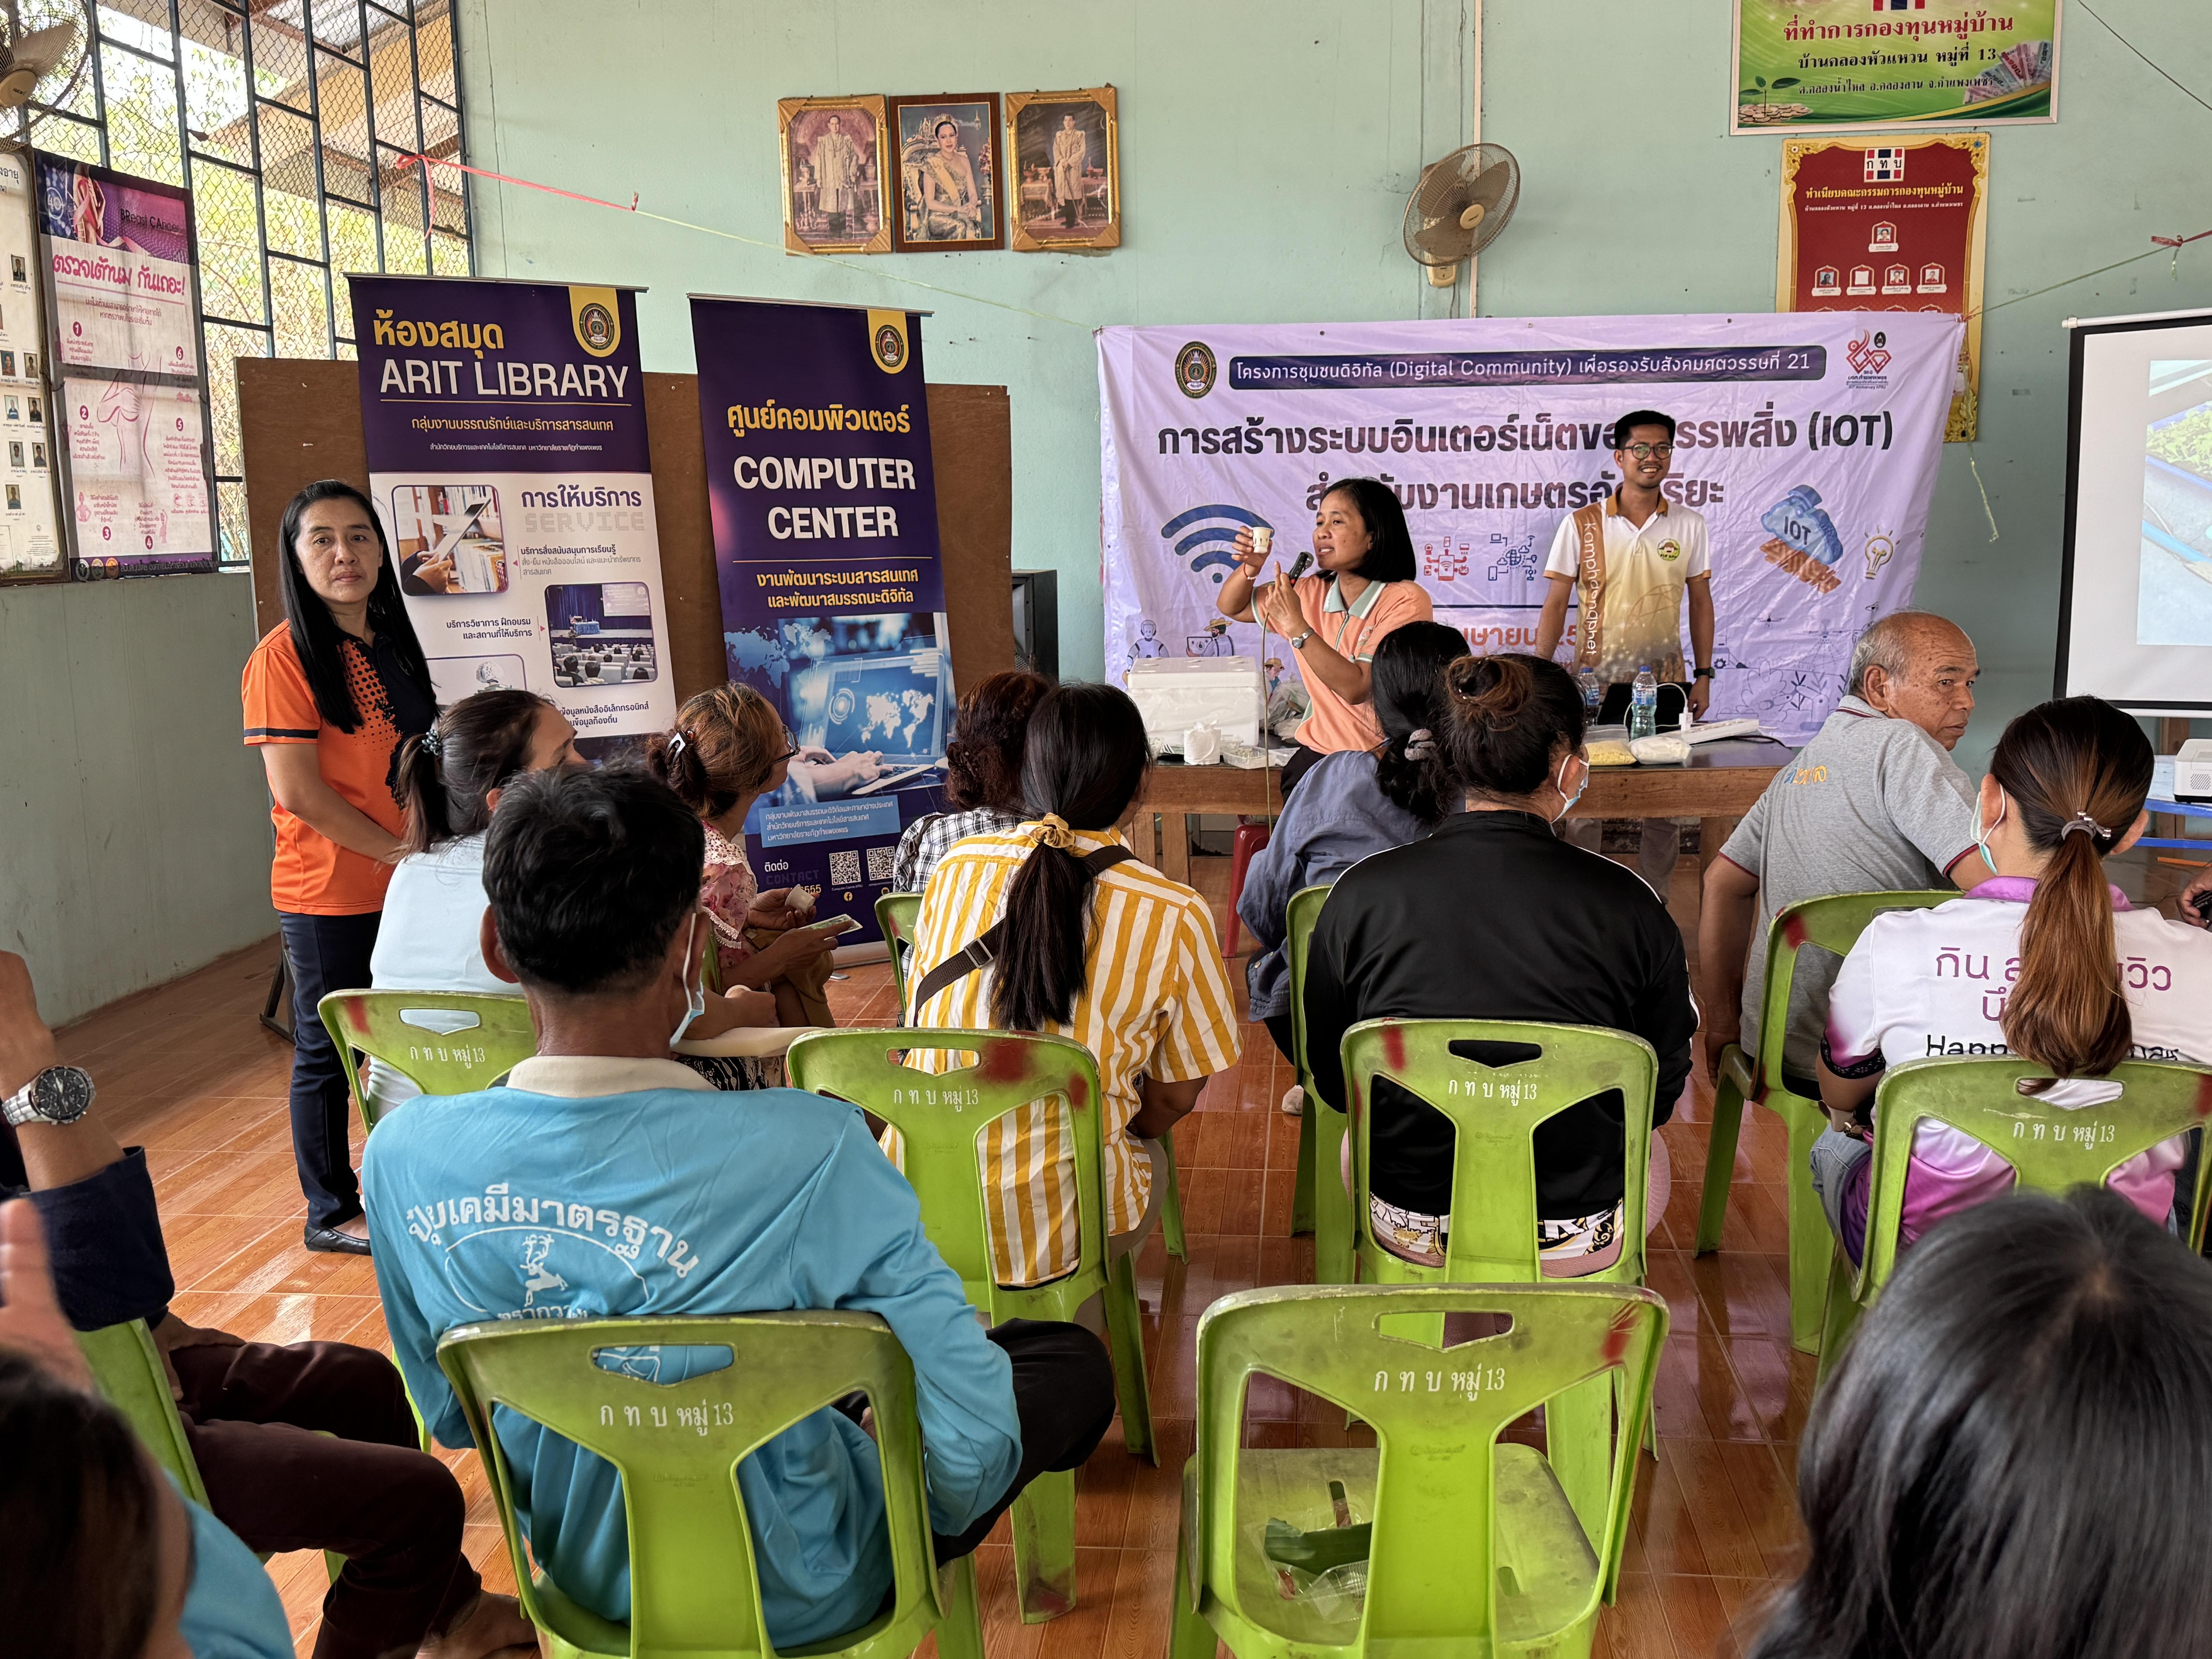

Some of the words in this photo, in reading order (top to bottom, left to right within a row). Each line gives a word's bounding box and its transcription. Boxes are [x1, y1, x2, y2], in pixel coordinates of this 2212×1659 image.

[1784, 10, 2013, 42] ที่ทำการกองทุนหมู่บ้าน
[1798, 50, 1927, 70] บ้านคลองหัวแหวน
[1936, 42, 1969, 66] หมู่ที่
[1978, 48, 1996, 60] 13
[1867, 159, 1874, 169] ก
[1880, 159, 1888, 169] ท
[1894, 158, 1902, 168] บ
[1806, 182, 1963, 199] ทำเนียบคณะกรรมการกองทุนหมู่บ้าน
[120, 209, 147, 226] BReast
[150, 216, 180, 231] CAncer
[53, 254, 132, 286] ตรวจเต้านม
[138, 265, 185, 296] กันเถอะ!
[374, 309, 504, 359] ห้องสมุด
[381, 359, 462, 393] ARIT
[475, 361, 629, 398] LIBRARY
[1237, 362, 1382, 384] โครงการชุมชนดิจิทัล
[1390, 360, 1454, 381] (Digital
[1460, 356, 1571, 378] Community)
[1579, 354, 1779, 374] เพื่อรองรับสังคมศตวรรษที่
[1787, 353, 1810, 370] 21
[412, 415, 613, 433] กลุ่มงานบรรณรักษ์และบริการสารสนเทศ
[727, 399, 910, 437] ศูนย์คอมพิวเตอร์
[1158, 402, 1796, 454] การสร้างระบบอินเตอร์เน็ตขอรรพสิ่ง
[1808, 410, 1892, 451] (IOT)
[733, 456, 916, 489] COMPUTER
[522, 484, 642, 508] การให้บริการ
[525, 512, 645, 532] SERVICE
[768, 506, 899, 539] CENTER
[1784, 516, 1811, 545] IOT
[521, 544, 616, 555] บริการสิ่งสนับสนุนการเรียนรู้
[757, 569, 918, 586] งานพัฒนาระบบสารสนเทศ
[768, 587, 914, 608] และพัฒนาสมรรถนะดิจิทัล
[447, 618, 499, 629] บริการวิชาการ
[500, 617, 531, 627] ฝึกอบรม
[463, 628, 532, 639] และสถานที่ให้บริการ
[560, 701, 649, 716] ข้อมูลหนังสืออิเล็กทรอนิกส์
[764, 859, 788, 872] ติดต่อ
[801, 884, 821, 894] 555
[1937, 947, 1989, 980] กิน
[410, 1047, 417, 1060] ก
[423, 1047, 433, 1061] ท
[438, 1048, 448, 1061] บ
[894, 1089, 902, 1104] ก
[909, 1089, 919, 1104] ท
[926, 1090, 936, 1104] บ
[1449, 1080, 1457, 1094] ก
[1465, 1081, 1475, 1096] ท
[1483, 1082, 1493, 1098] บ
[2013, 1122, 2024, 1137] ก
[2033, 1122, 2045, 1140] ท
[2054, 1125, 2065, 1141] บ
[407, 1182, 699, 1278] ปุ๋ยเคมีมาตรฐาน
[1375, 1371, 1388, 1391] ก
[1400, 1371, 1415, 1391] ท
[1426, 1371, 1441, 1391] บ
[601, 1405, 613, 1425] ก
[623, 1406, 640, 1426] ท
[650, 1406, 667, 1427] บ
